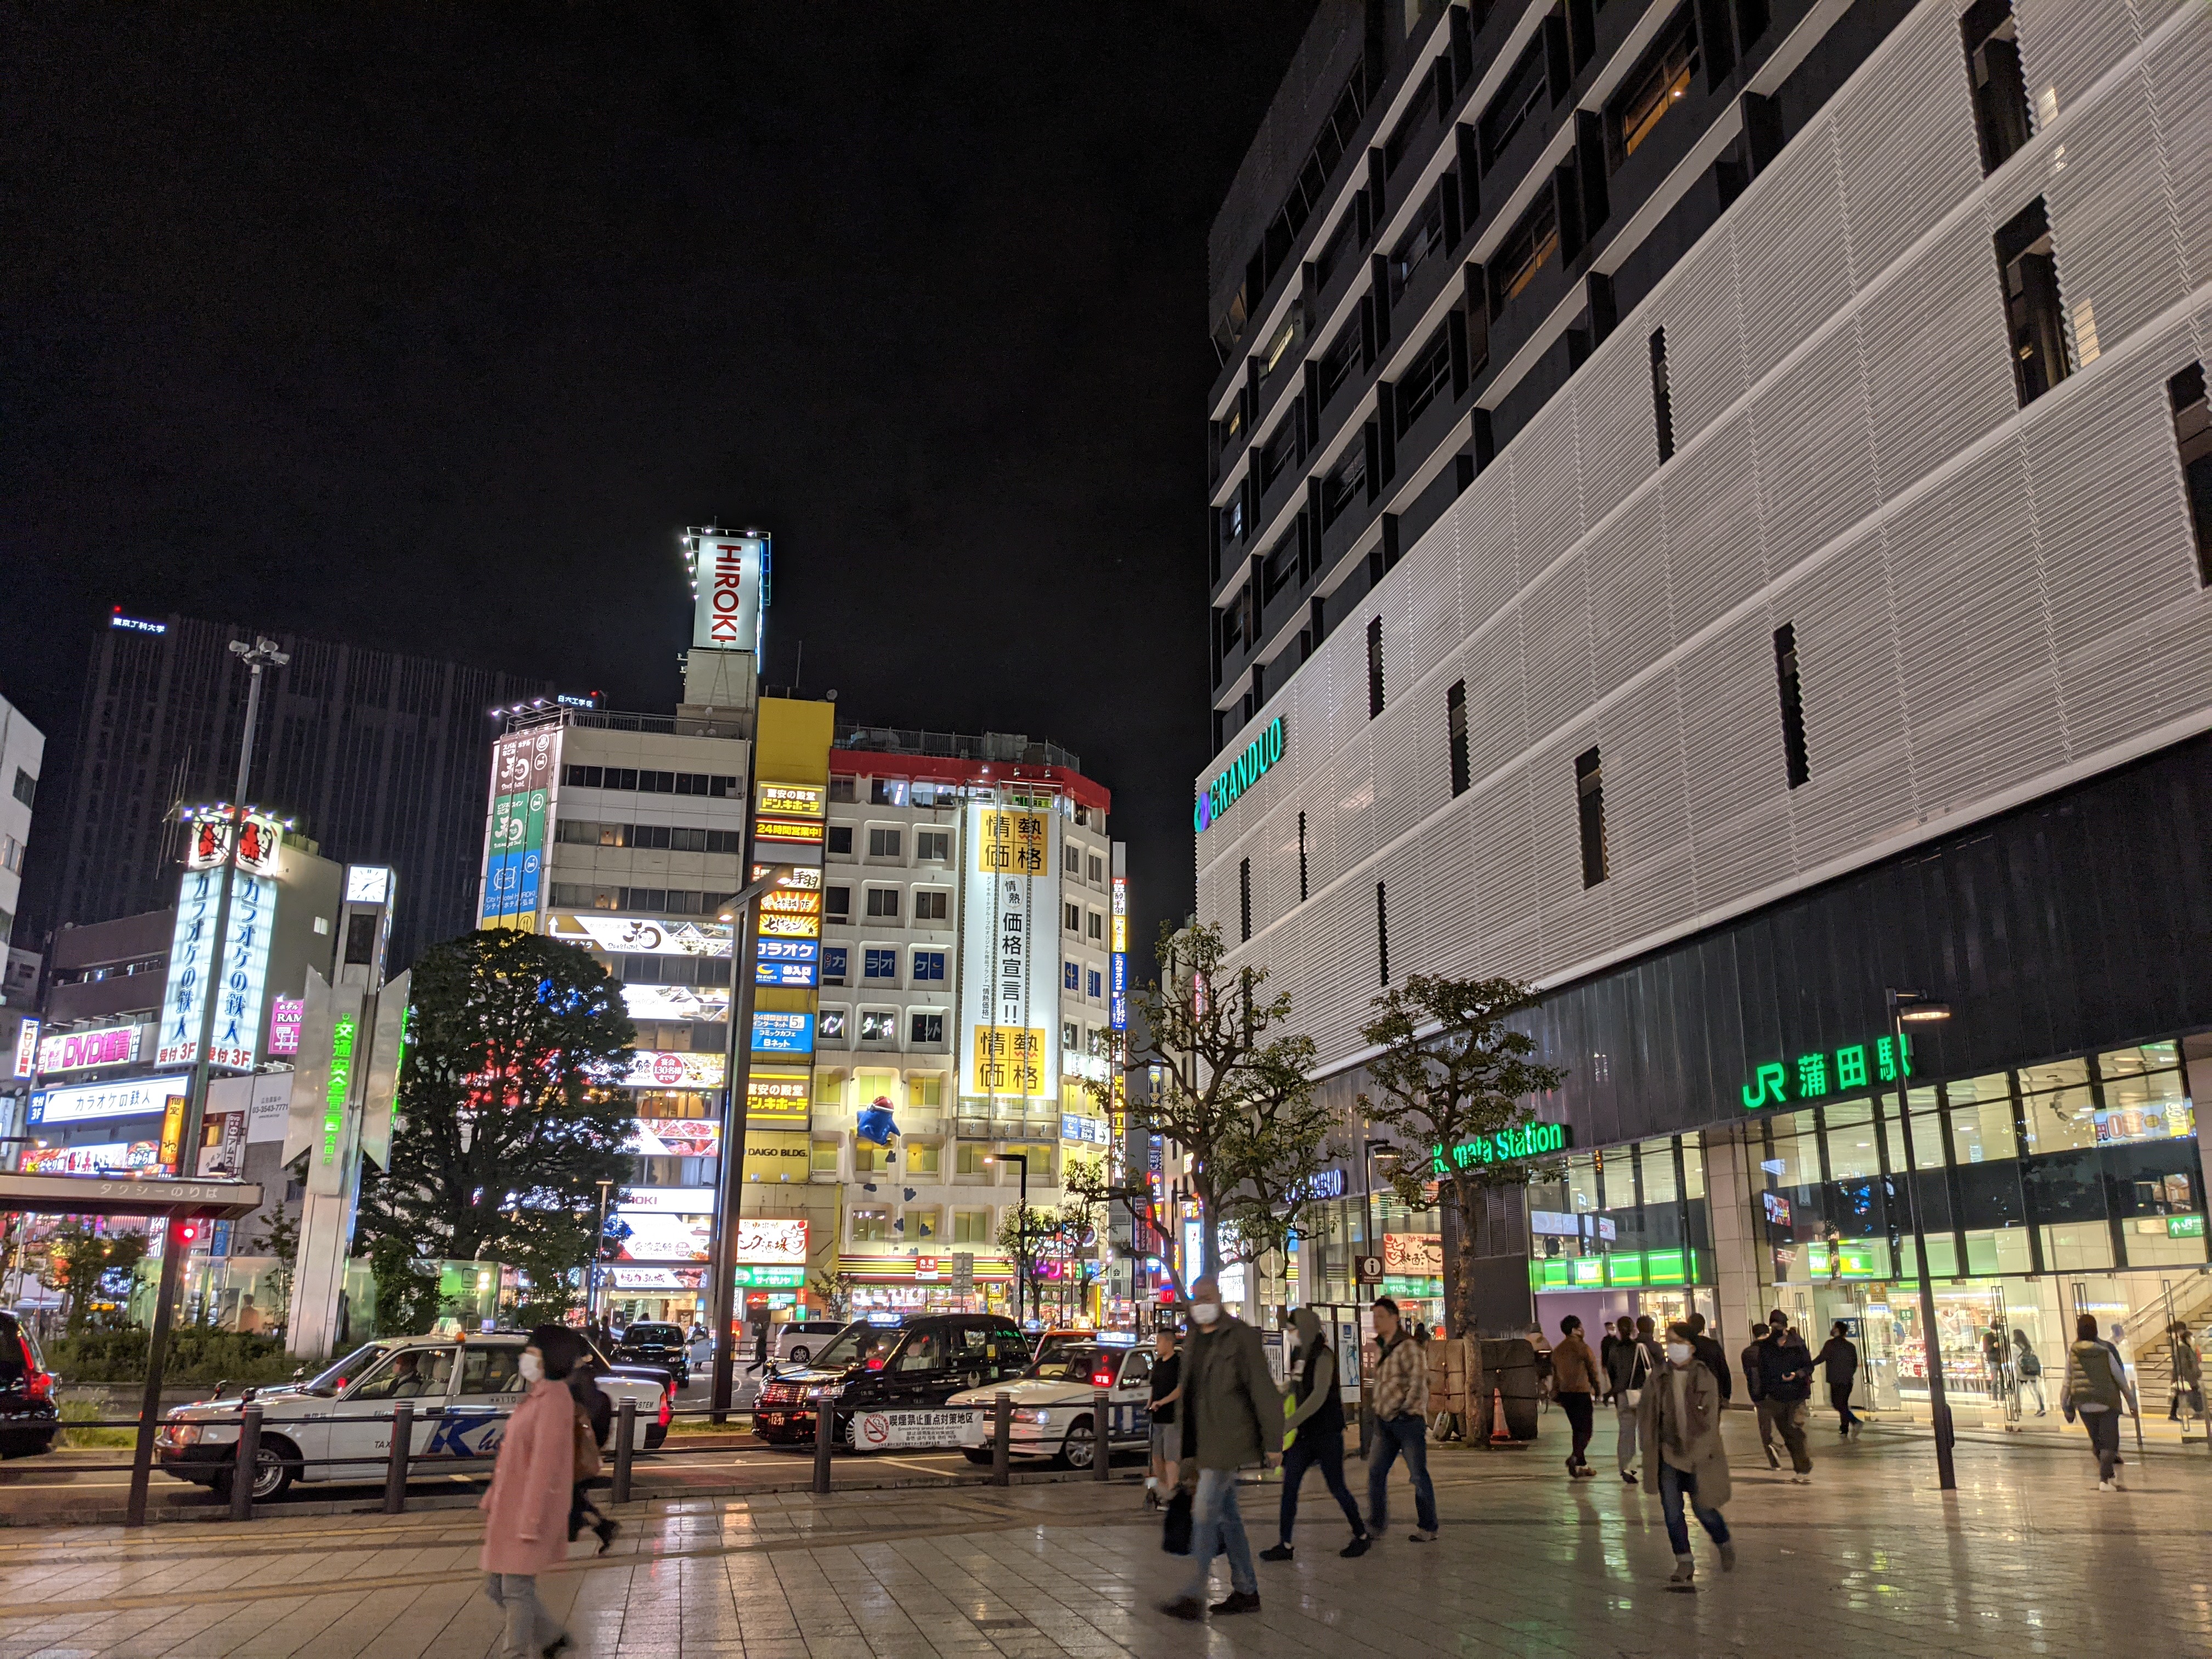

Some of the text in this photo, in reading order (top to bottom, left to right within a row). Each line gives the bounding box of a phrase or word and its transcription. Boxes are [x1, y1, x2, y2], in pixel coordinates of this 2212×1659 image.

[712, 544, 741, 641] HIROKI
[1210, 718, 1282, 820] GRANDUO
[757, 824, 822, 837] 24時間営業中!
[1005, 881, 1020, 904] 情熱
[172, 873, 208, 1040] カラオケの鉄人
[222, 878, 260, 1043] カラオケの鉄人
[782, 966, 811, 976] お入口
[792, 1017, 803, 1027] 5F
[62, 1029, 132, 1068] DVD鑑賞
[159, 1042, 197, 1063] 受付 3F
[231, 1048, 252, 1068] 3F
[324, 1021, 354, 1132] 交通安全宣言
[653, 1066, 682, 1075] 130名様
[1742, 1033, 1911, 1108] JR 蒲田駅
[32, 1096, 45, 1107] 受付
[75, 1088, 150, 1111] カラオケの鉄人
[169, 1096, 182, 1116] 個室
[31, 1108, 42, 1120] 3F
[1063, 1115, 1078, 1124] カラオケ
[323, 1135, 337, 1165] 大田区
[748, 1148, 808, 1157] DAIGO BLDG.
[1433, 1121, 1562, 1173] Kmata Station
[2181, 1218, 2193, 1228] JR
[755, 1276, 791, 1285] サイゼリヤ
[771, 1417, 785, 1425] 12-97
[375, 1441, 391, 1449] TAX
